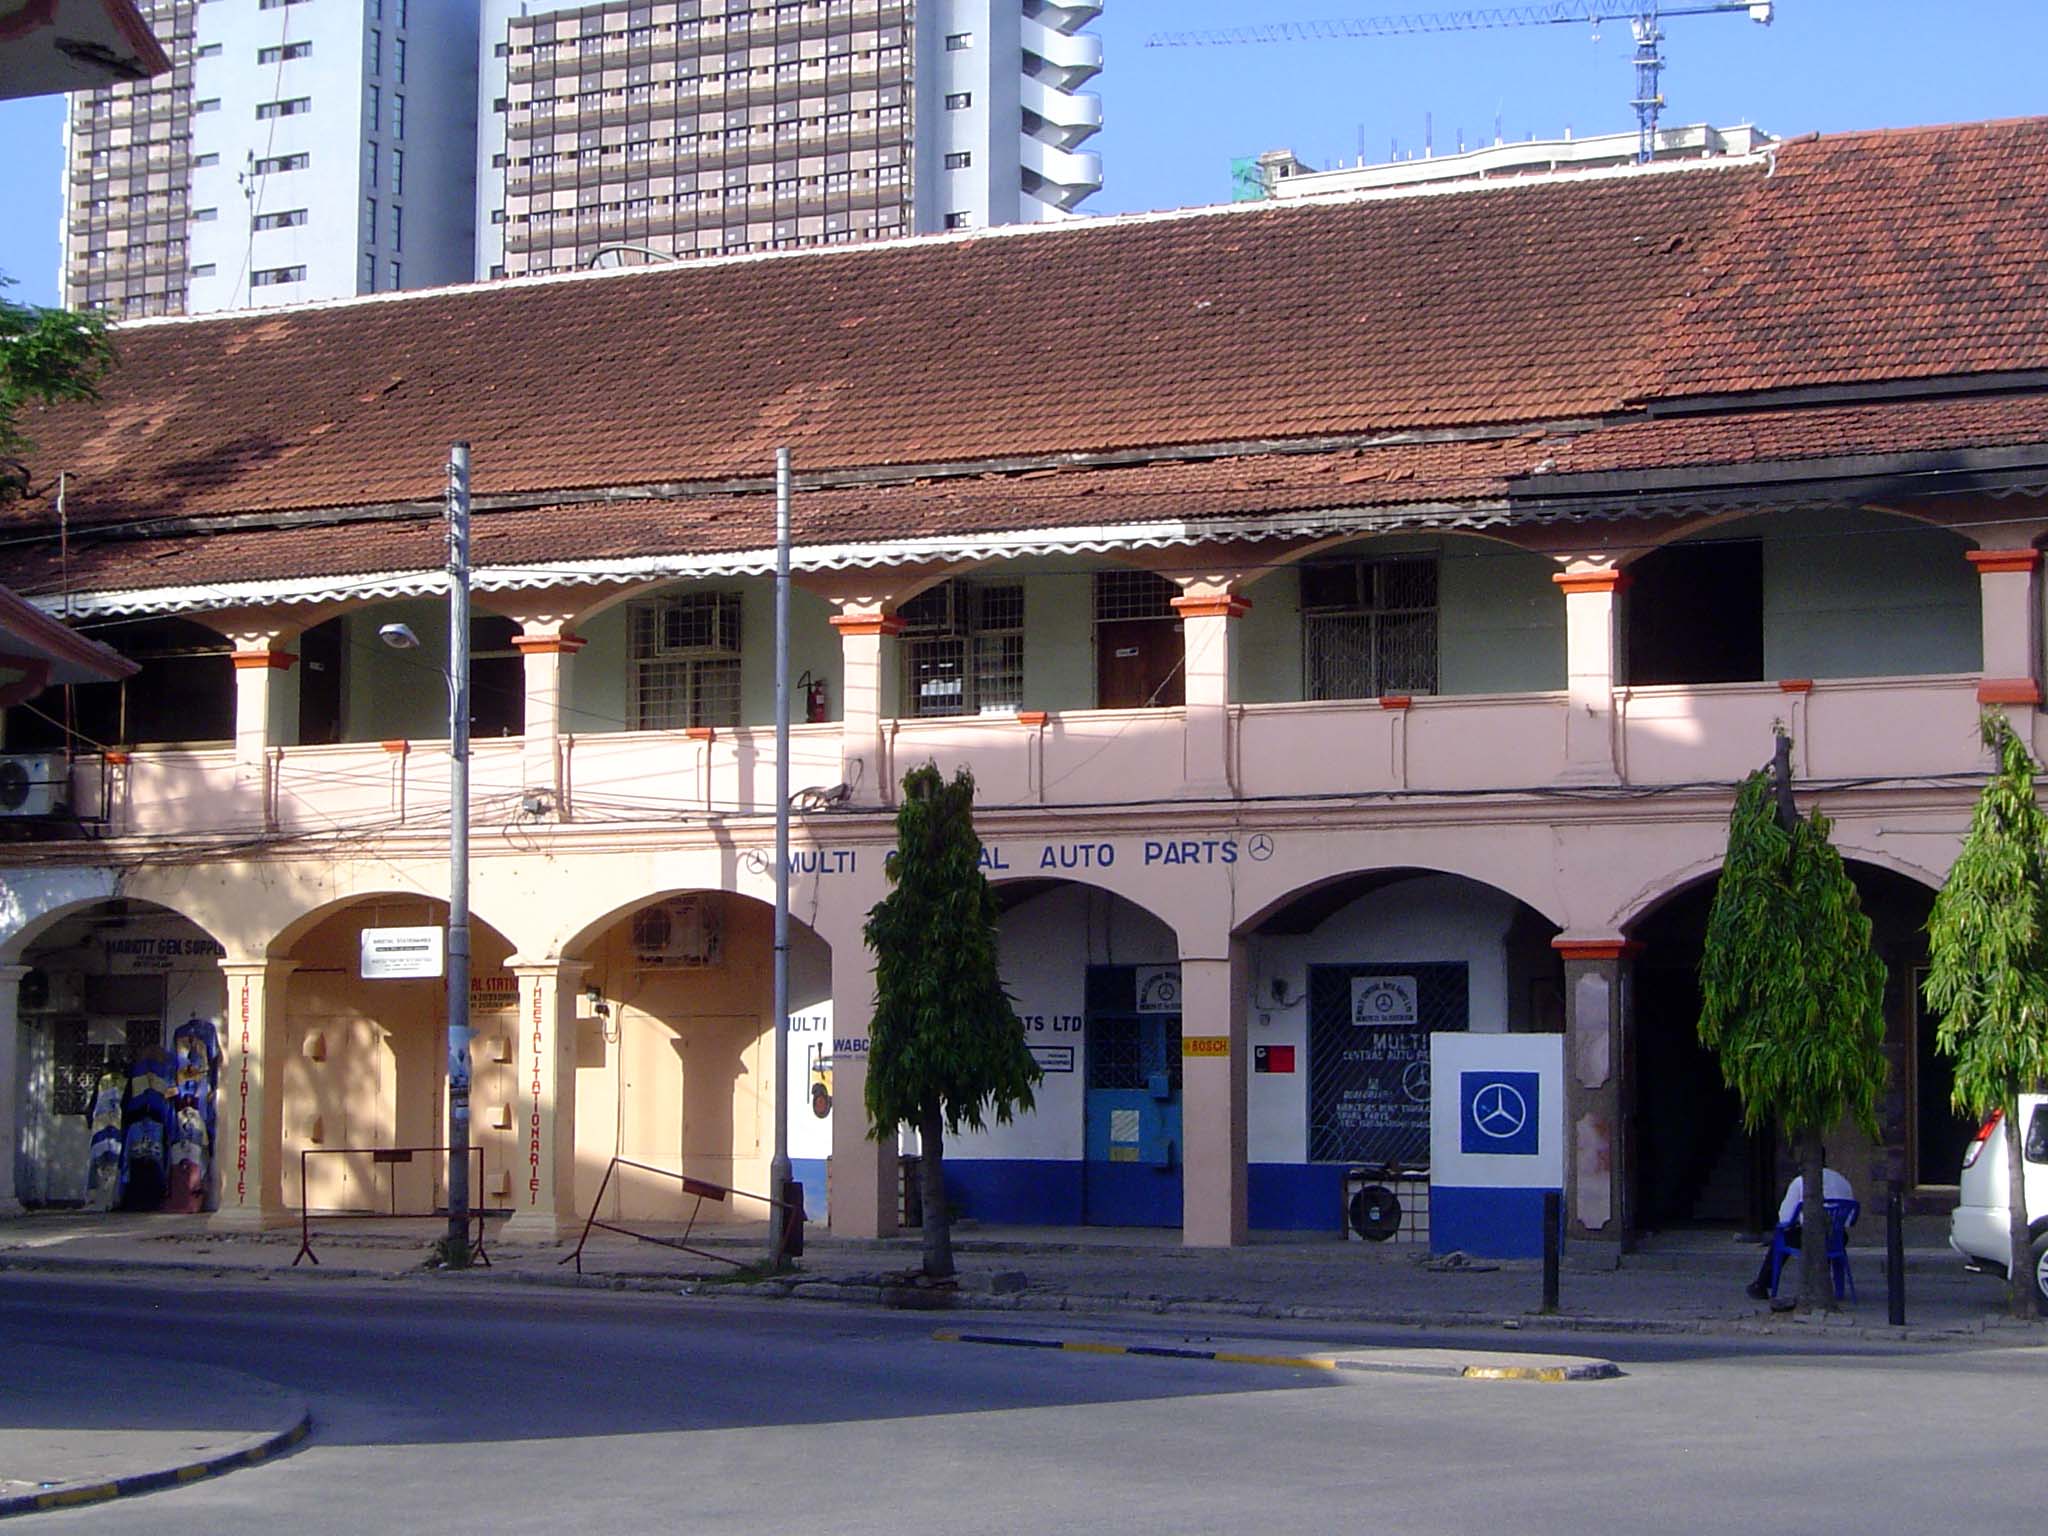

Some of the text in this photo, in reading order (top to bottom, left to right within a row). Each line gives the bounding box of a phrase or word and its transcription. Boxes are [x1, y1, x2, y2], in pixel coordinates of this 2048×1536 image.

[787, 851, 856, 873] MULTI
[1040, 843, 1115, 869] AUTO
[1144, 840, 1238, 865] PARTS
[1053, 1016, 1082, 1032] LTD
[1191, 1040, 1227, 1052] BOSCH
[1373, 1033, 1426, 1050] MULTI
